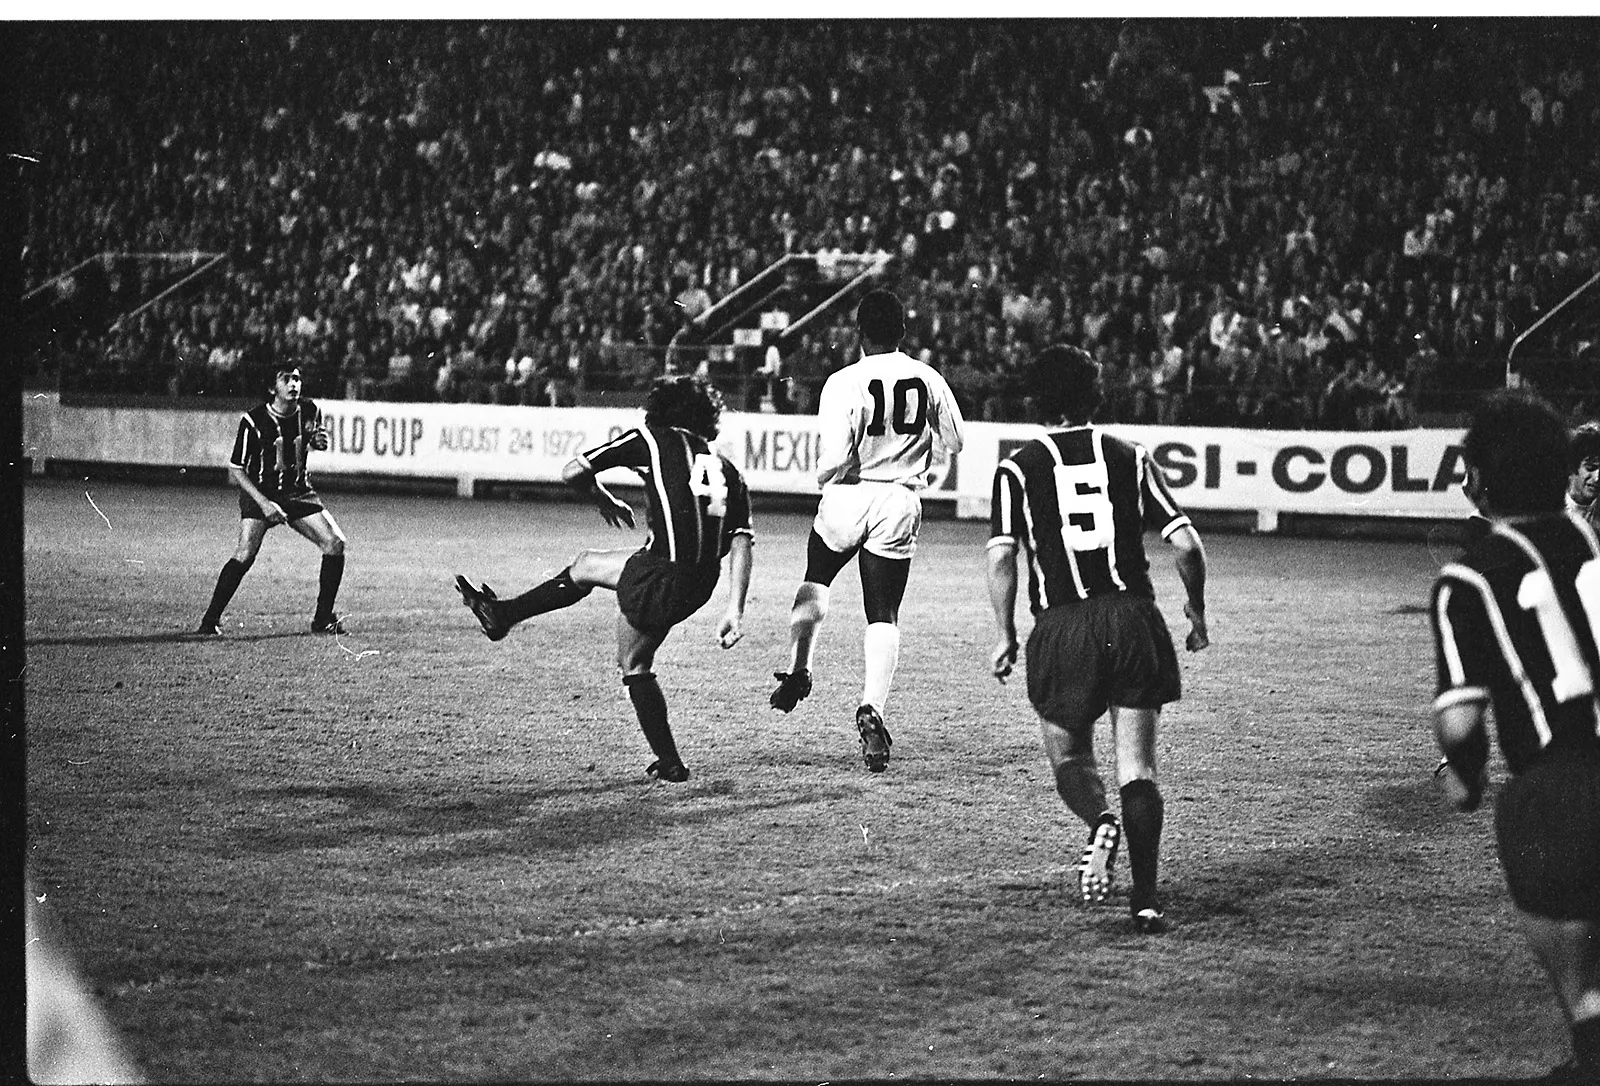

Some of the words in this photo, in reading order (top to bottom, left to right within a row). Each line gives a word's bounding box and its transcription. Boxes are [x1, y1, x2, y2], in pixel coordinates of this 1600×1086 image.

[324, 413, 366, 454] RLD
[373, 416, 423, 457] CUP
[438, 425, 500, 454] AUGUST
[508, 427, 534, 455] 24
[542, 430, 588, 457] 1972
[866, 377, 927, 437] 10
[745, 429, 822, 472] MEXI
[999, 439, 1467, 494] SI-COLA
[688, 454, 728, 517] 4
[1055, 462, 1114, 551] 5
